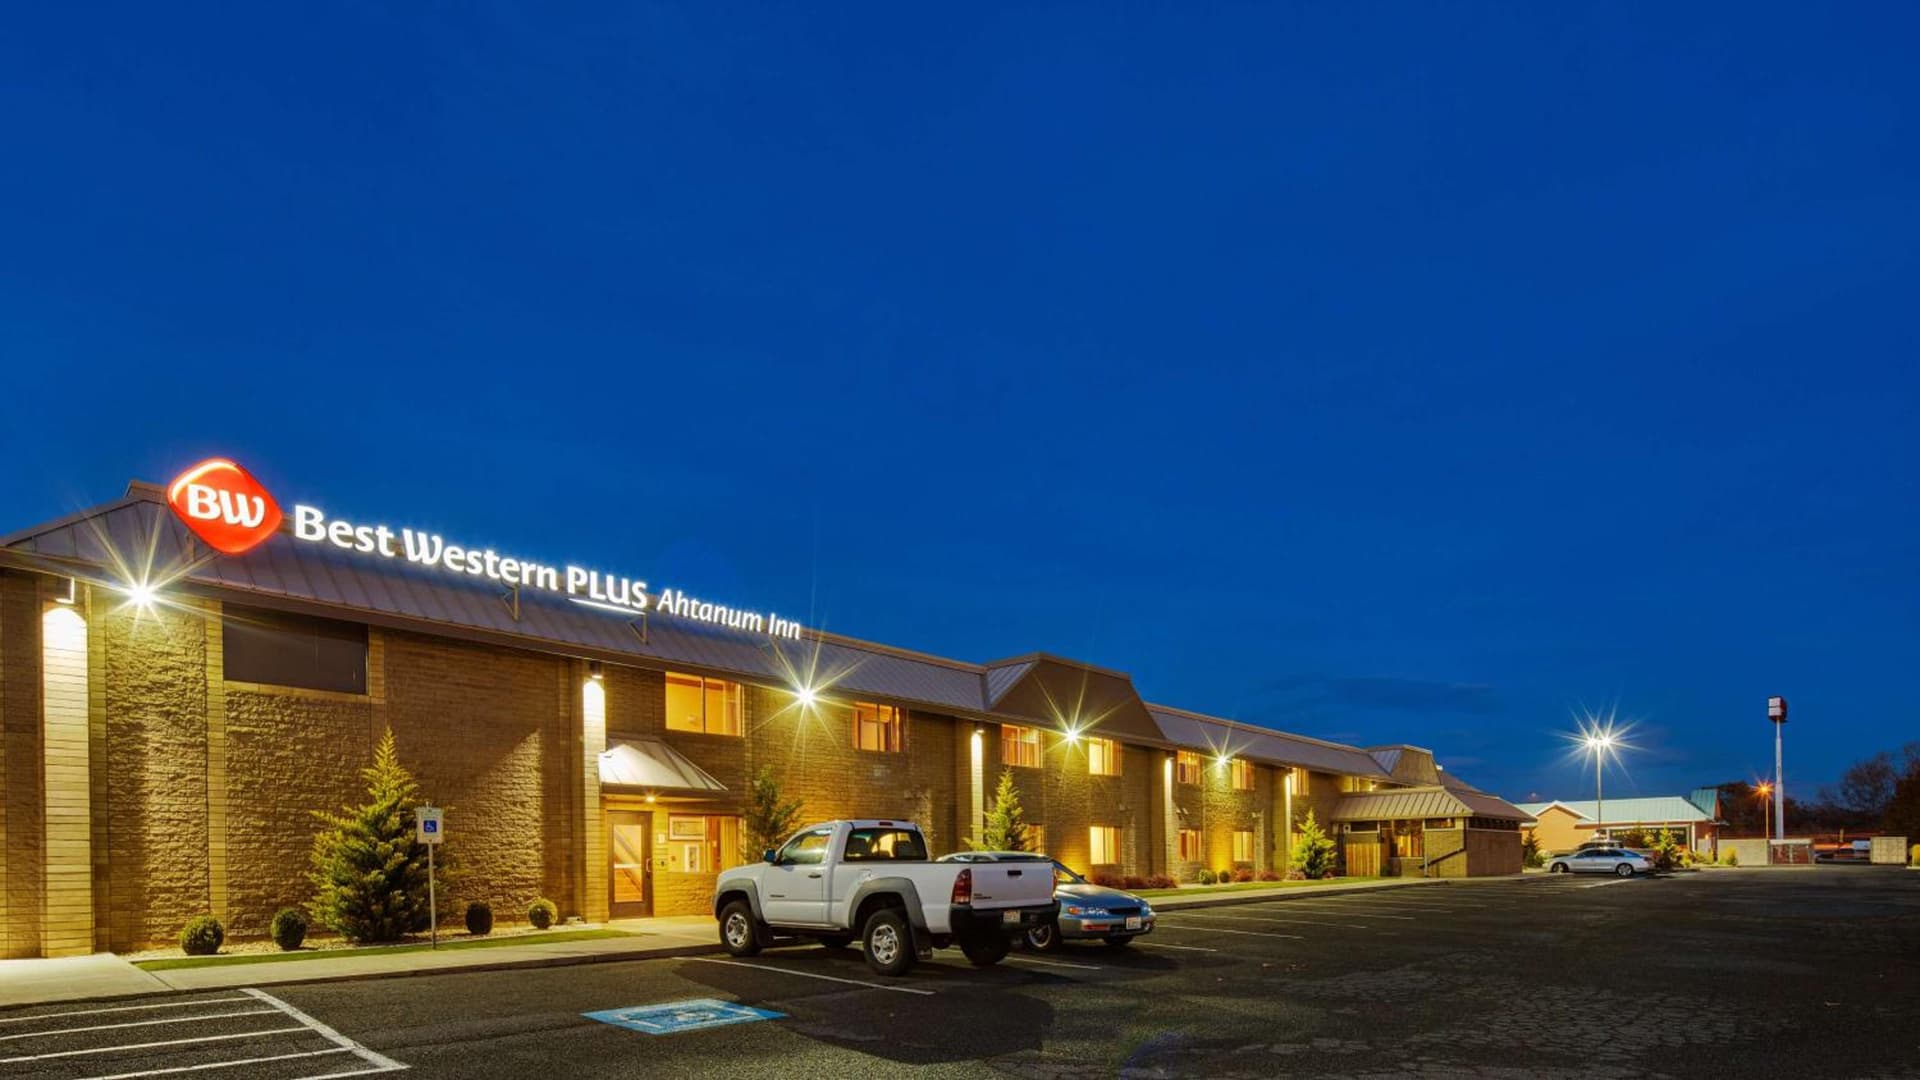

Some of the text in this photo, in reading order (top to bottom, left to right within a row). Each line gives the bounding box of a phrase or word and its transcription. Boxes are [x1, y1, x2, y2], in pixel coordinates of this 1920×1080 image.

[187, 483, 265, 528] BW
[294, 504, 801, 641] Best Western PLUS Ahtanum Inn
